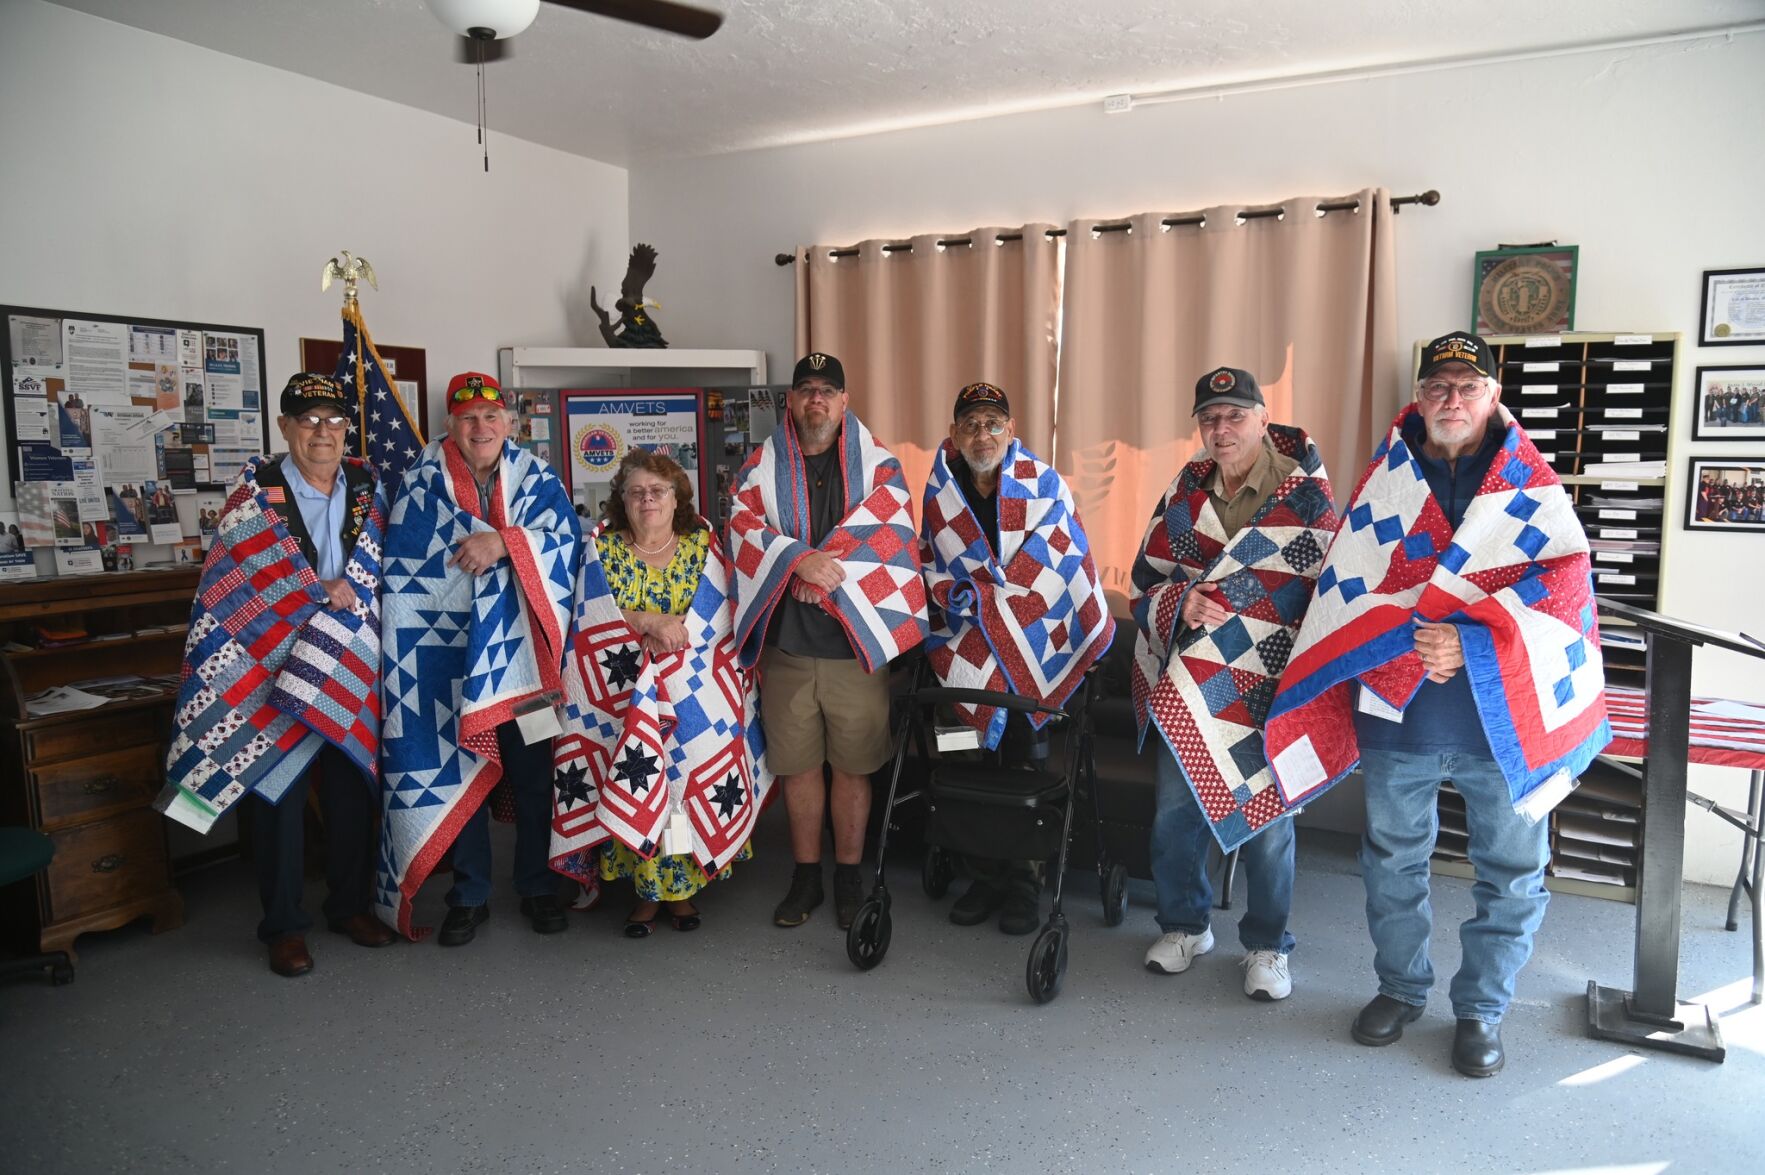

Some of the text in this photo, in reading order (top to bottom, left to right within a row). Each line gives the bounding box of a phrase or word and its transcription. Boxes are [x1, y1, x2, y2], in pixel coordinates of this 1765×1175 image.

[299, 378, 335, 388] VIENAM
[302, 390, 336, 399] VETERAN
[599, 401, 666, 414] AMVETS
[654, 425, 693, 433] america
